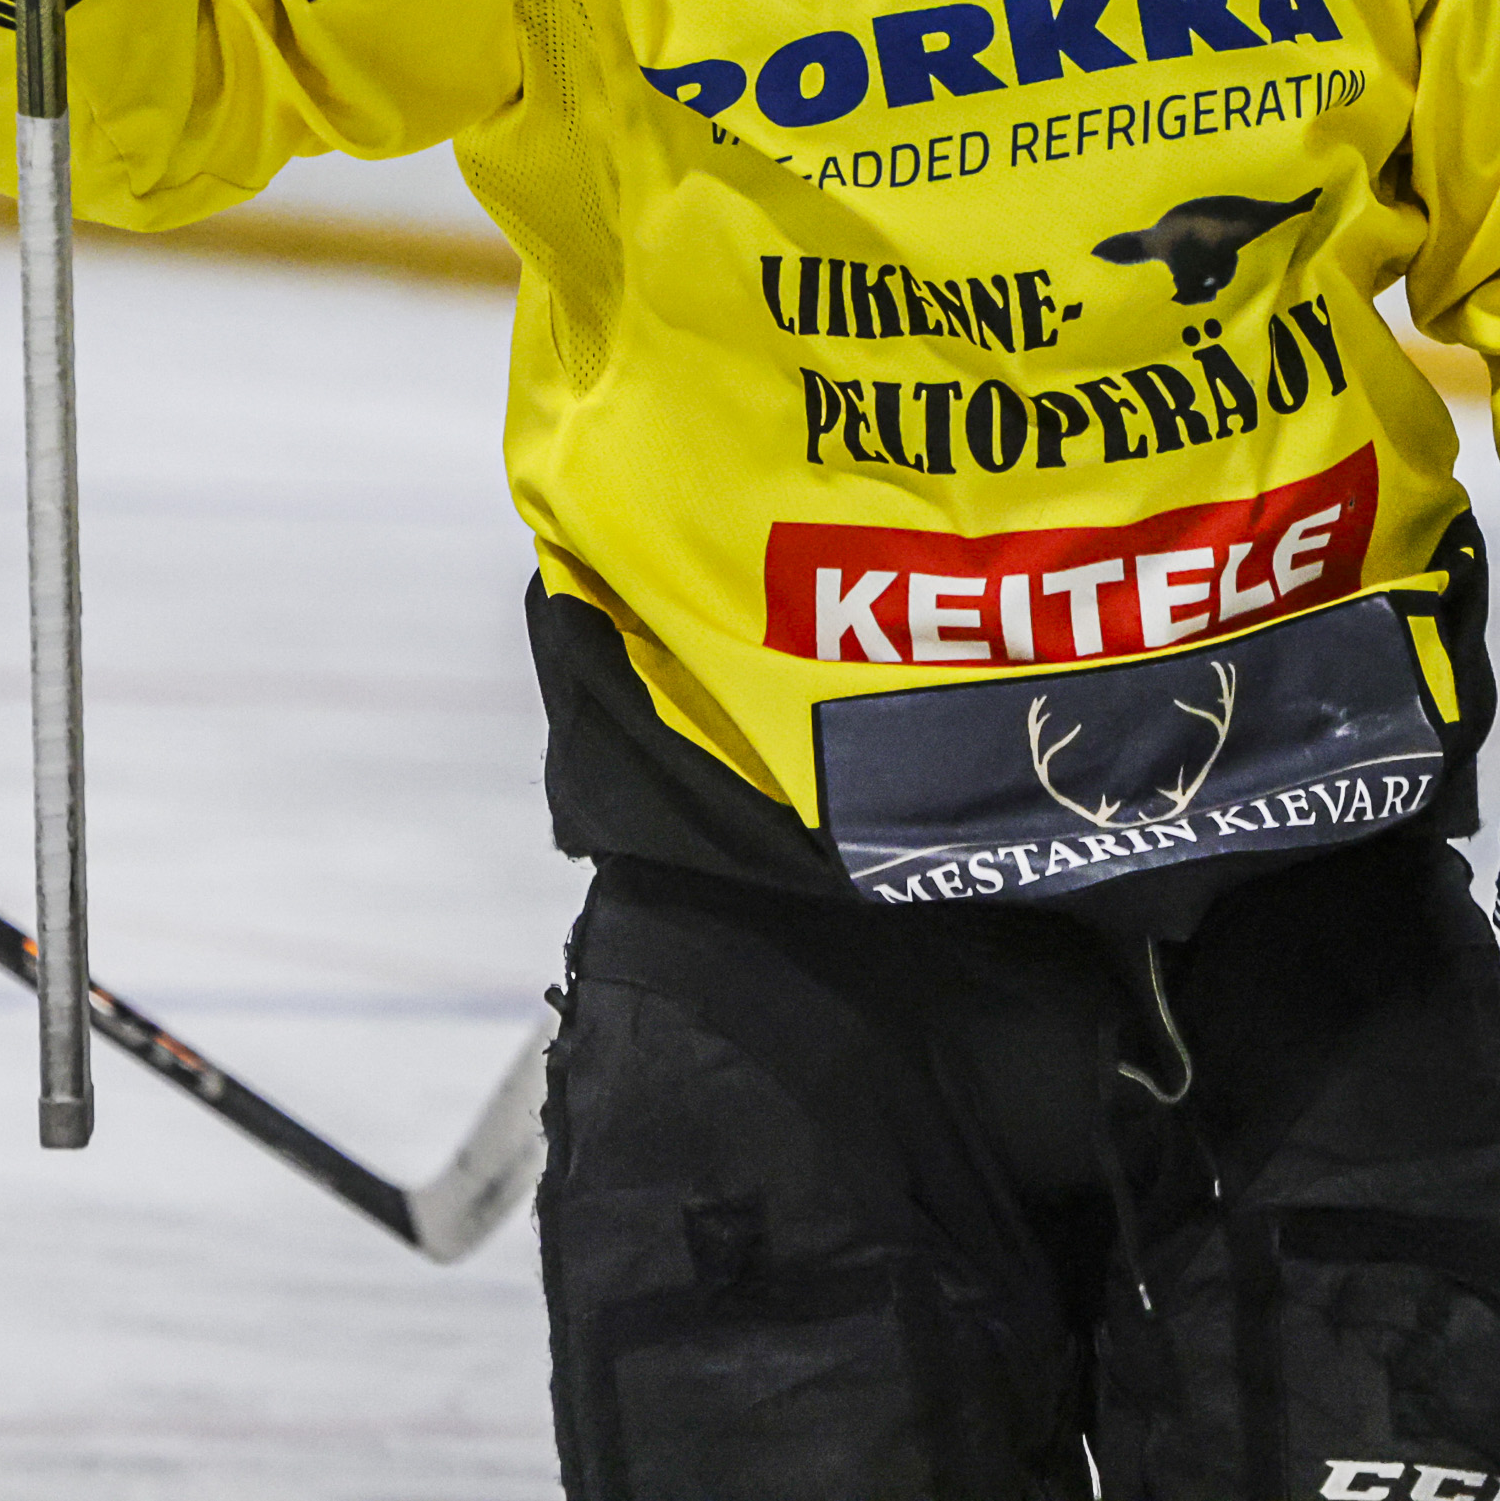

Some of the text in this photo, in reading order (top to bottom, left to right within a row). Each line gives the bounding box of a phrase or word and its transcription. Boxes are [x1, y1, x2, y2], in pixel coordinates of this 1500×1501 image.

[1010, 69, 1366, 168] REFRIGERATION
[759, 255, 1084, 354] LIIKENNE-
[798, 293, 1348, 475] PELTOPERÄ OY
[815, 502, 1342, 664] KEITELE
[872, 774, 1433, 904] MESTARIN KIEVARI
